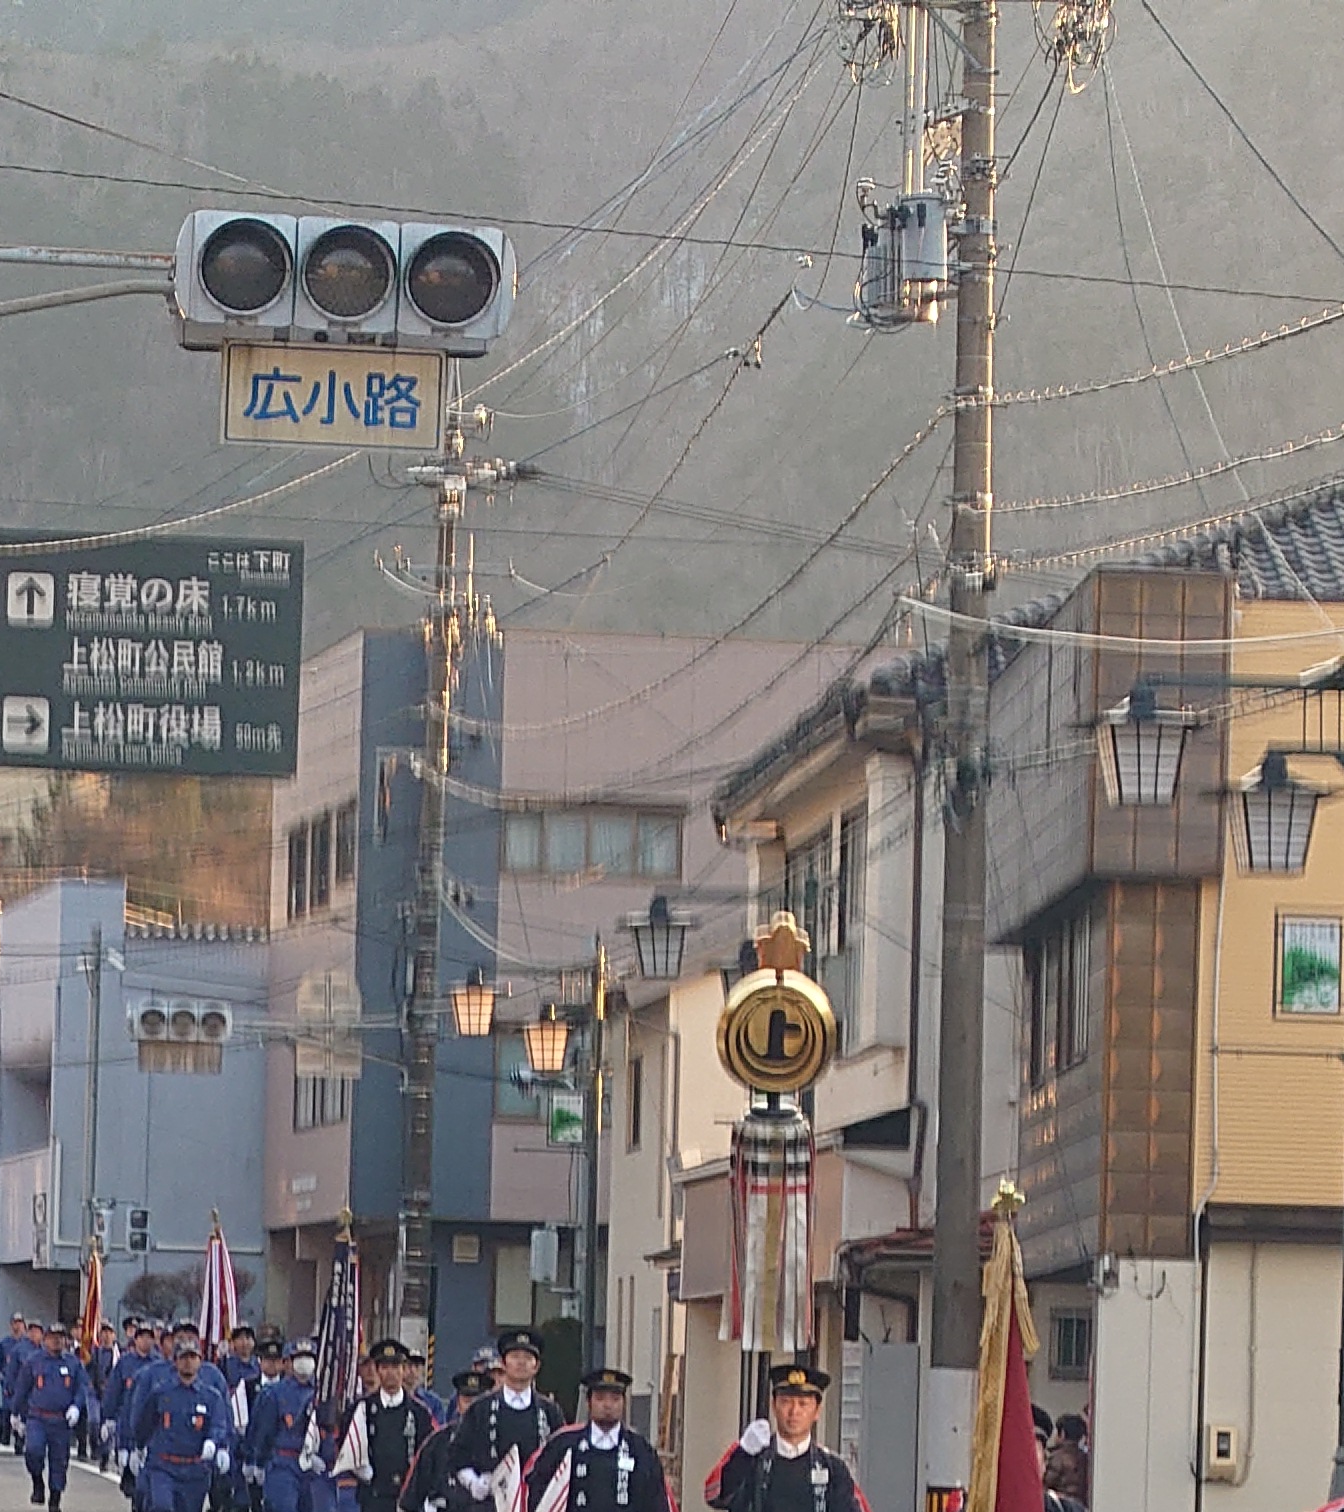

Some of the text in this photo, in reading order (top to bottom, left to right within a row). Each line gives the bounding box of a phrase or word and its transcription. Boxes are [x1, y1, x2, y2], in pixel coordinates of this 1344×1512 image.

[243, 366, 421, 430] 広小路
[67, 571, 210, 614] 寝覚の床
[63, 636, 223, 683] 上松町公民館
[62, 701, 221, 750] 上松町役場
